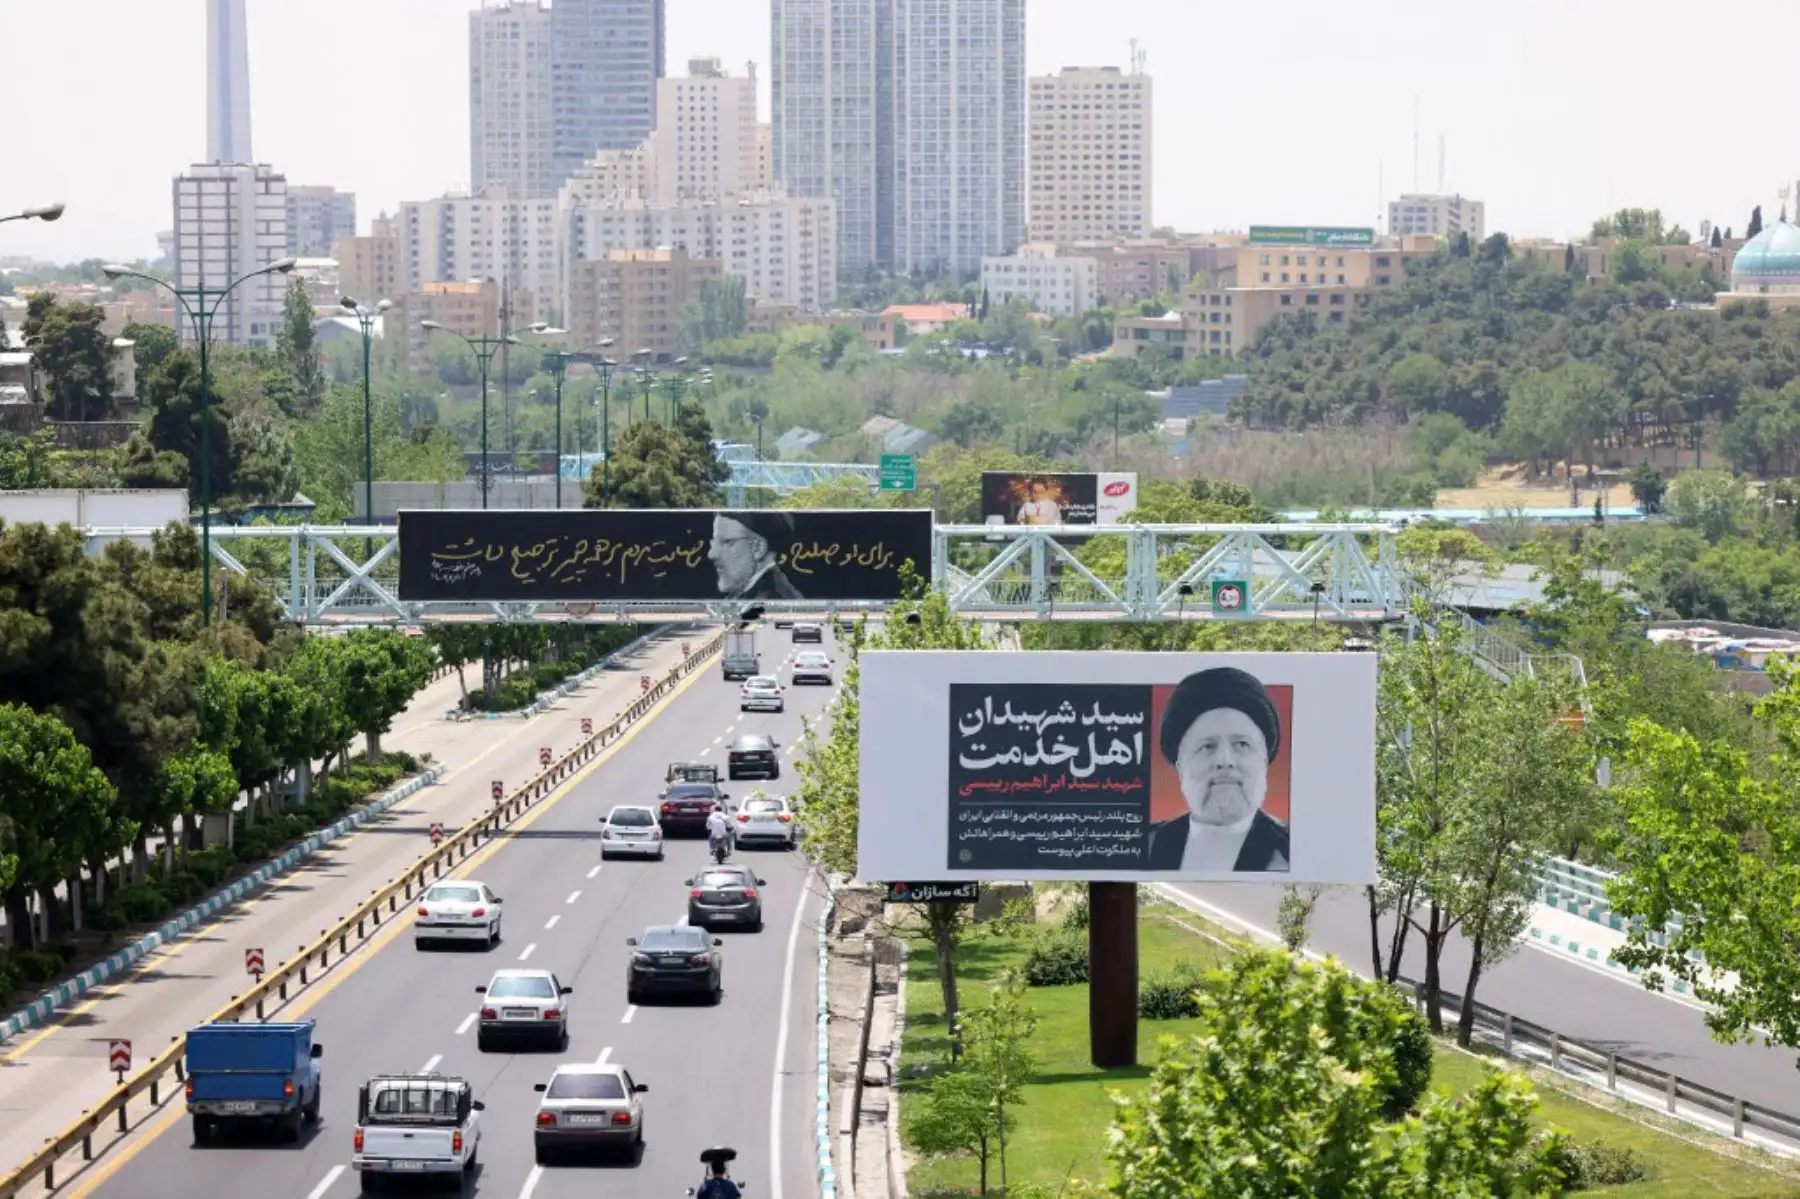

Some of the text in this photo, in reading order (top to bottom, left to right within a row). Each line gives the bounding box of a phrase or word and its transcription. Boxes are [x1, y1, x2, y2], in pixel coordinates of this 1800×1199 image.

[430, 536, 504, 562] داشت
[839, 543, 858, 567] او
[856, 540, 895, 570] برای
[510, 538, 560, 584] ترجیح
[602, 542, 623, 578] بر
[620, 543, 651, 585] مردم
[778, 552, 788, 566] و
[1081, 700, 1145, 733] سید
[958, 731, 1144, 778] اهل خدمت
[1010, 773, 1066, 795] ابراهیم
[1067, 777, 1100, 793] سید
[1102, 777, 1143, 795] شهید
[982, 809, 1012, 823] انقلابی
[1018, 811, 1049, 824] مردمی
[1047, 811, 1078, 824] جمهور
[1106, 810, 1125, 823] بلند
[1125, 812, 1143, 824] روح
[958, 827, 1010, 842] همراهانش
[1051, 826, 1089, 841] ابراهیم
[1089, 828, 1112, 841] سید
[1112, 827, 1143, 842] شهید
[1037, 846, 1074, 858] پیوست
[1095, 844, 1131, 857] ملکوت
[1130, 846, 1142, 859] به
[911, 884, 952, 901] سازان
